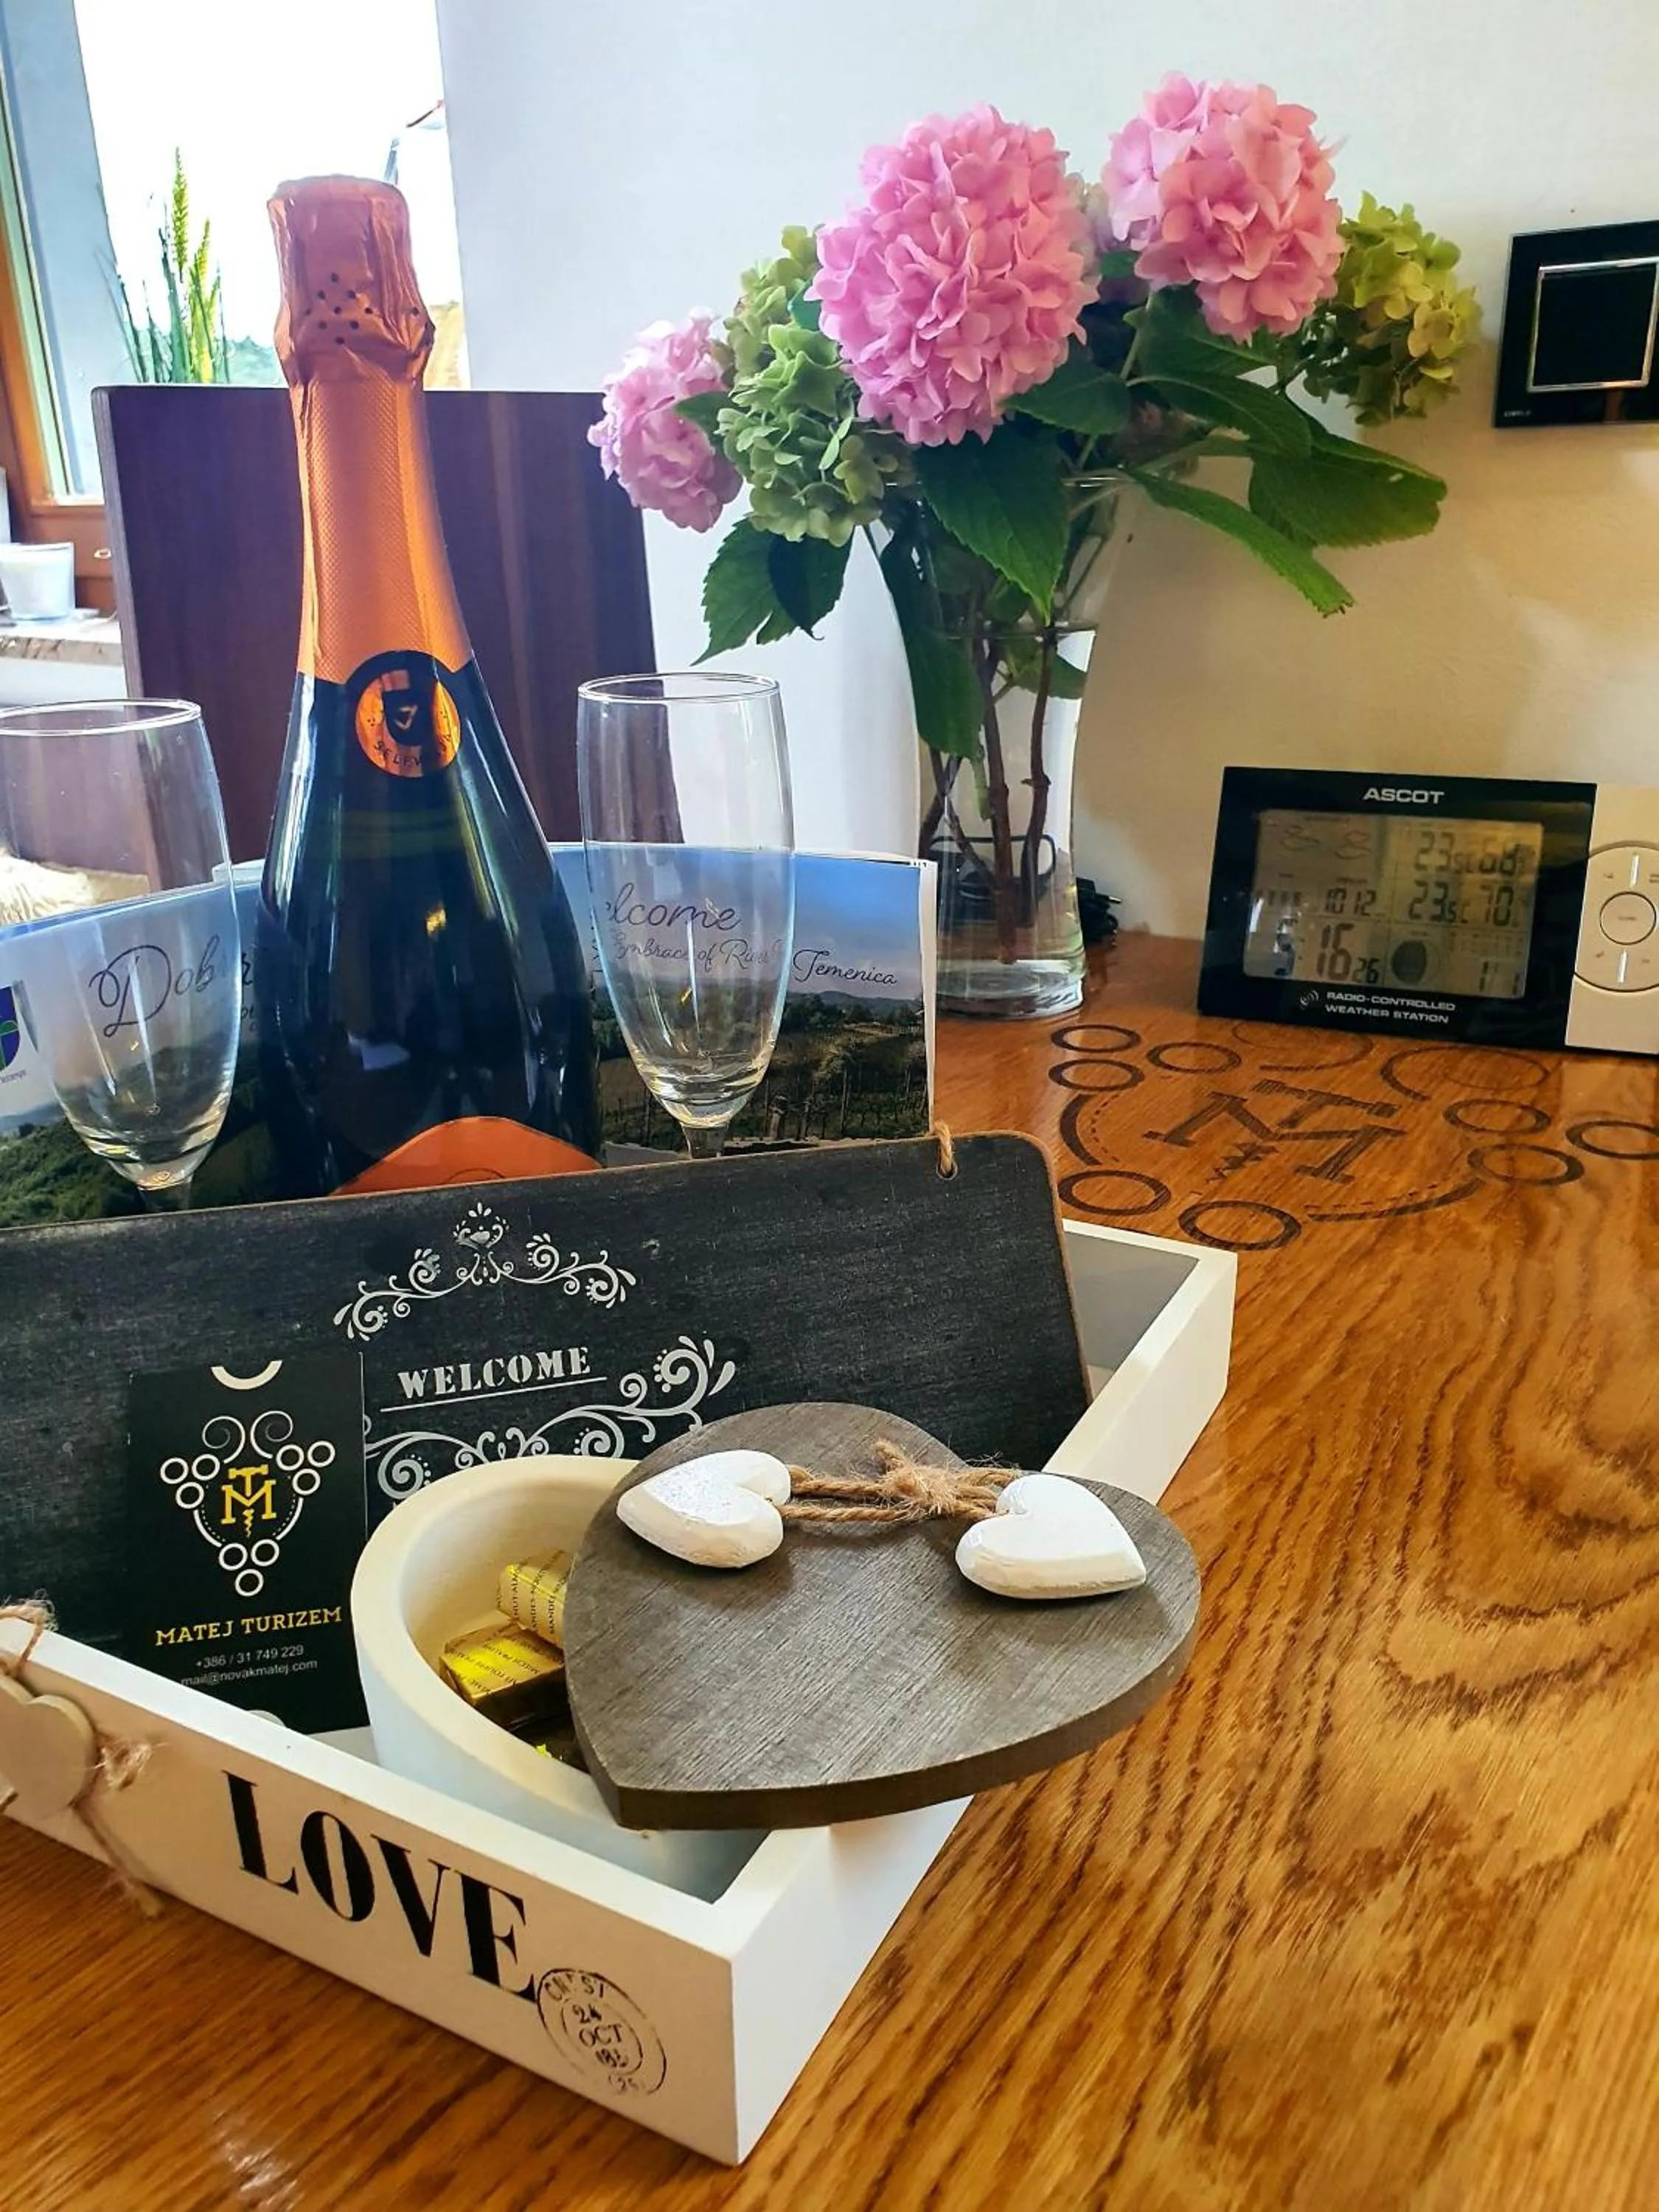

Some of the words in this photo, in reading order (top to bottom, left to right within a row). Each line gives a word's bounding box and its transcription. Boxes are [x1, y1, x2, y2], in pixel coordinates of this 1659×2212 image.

[1363, 787, 1445, 804] ASCOT
[605, 882, 741, 931] lcome
[793, 949, 897, 984] Temenica
[1325, 1004, 1389, 1018] WEATHER
[1393, 1012, 1449, 1024] STATION
[1326, 992, 1456, 1011] RADIO-CONTROLLED
[397, 1346, 591, 1399] WELCOME
[155, 1621, 234, 1646] MATEJ
[240, 1606, 343, 1635] TURIZEM
[237, 1650, 251, 1663] 31
[256, 1646, 279, 1660] 749
[281, 1644, 304, 1658] 229
[223, 1770, 536, 2003] LOVE
[579, 2023, 622, 2048] OCT
